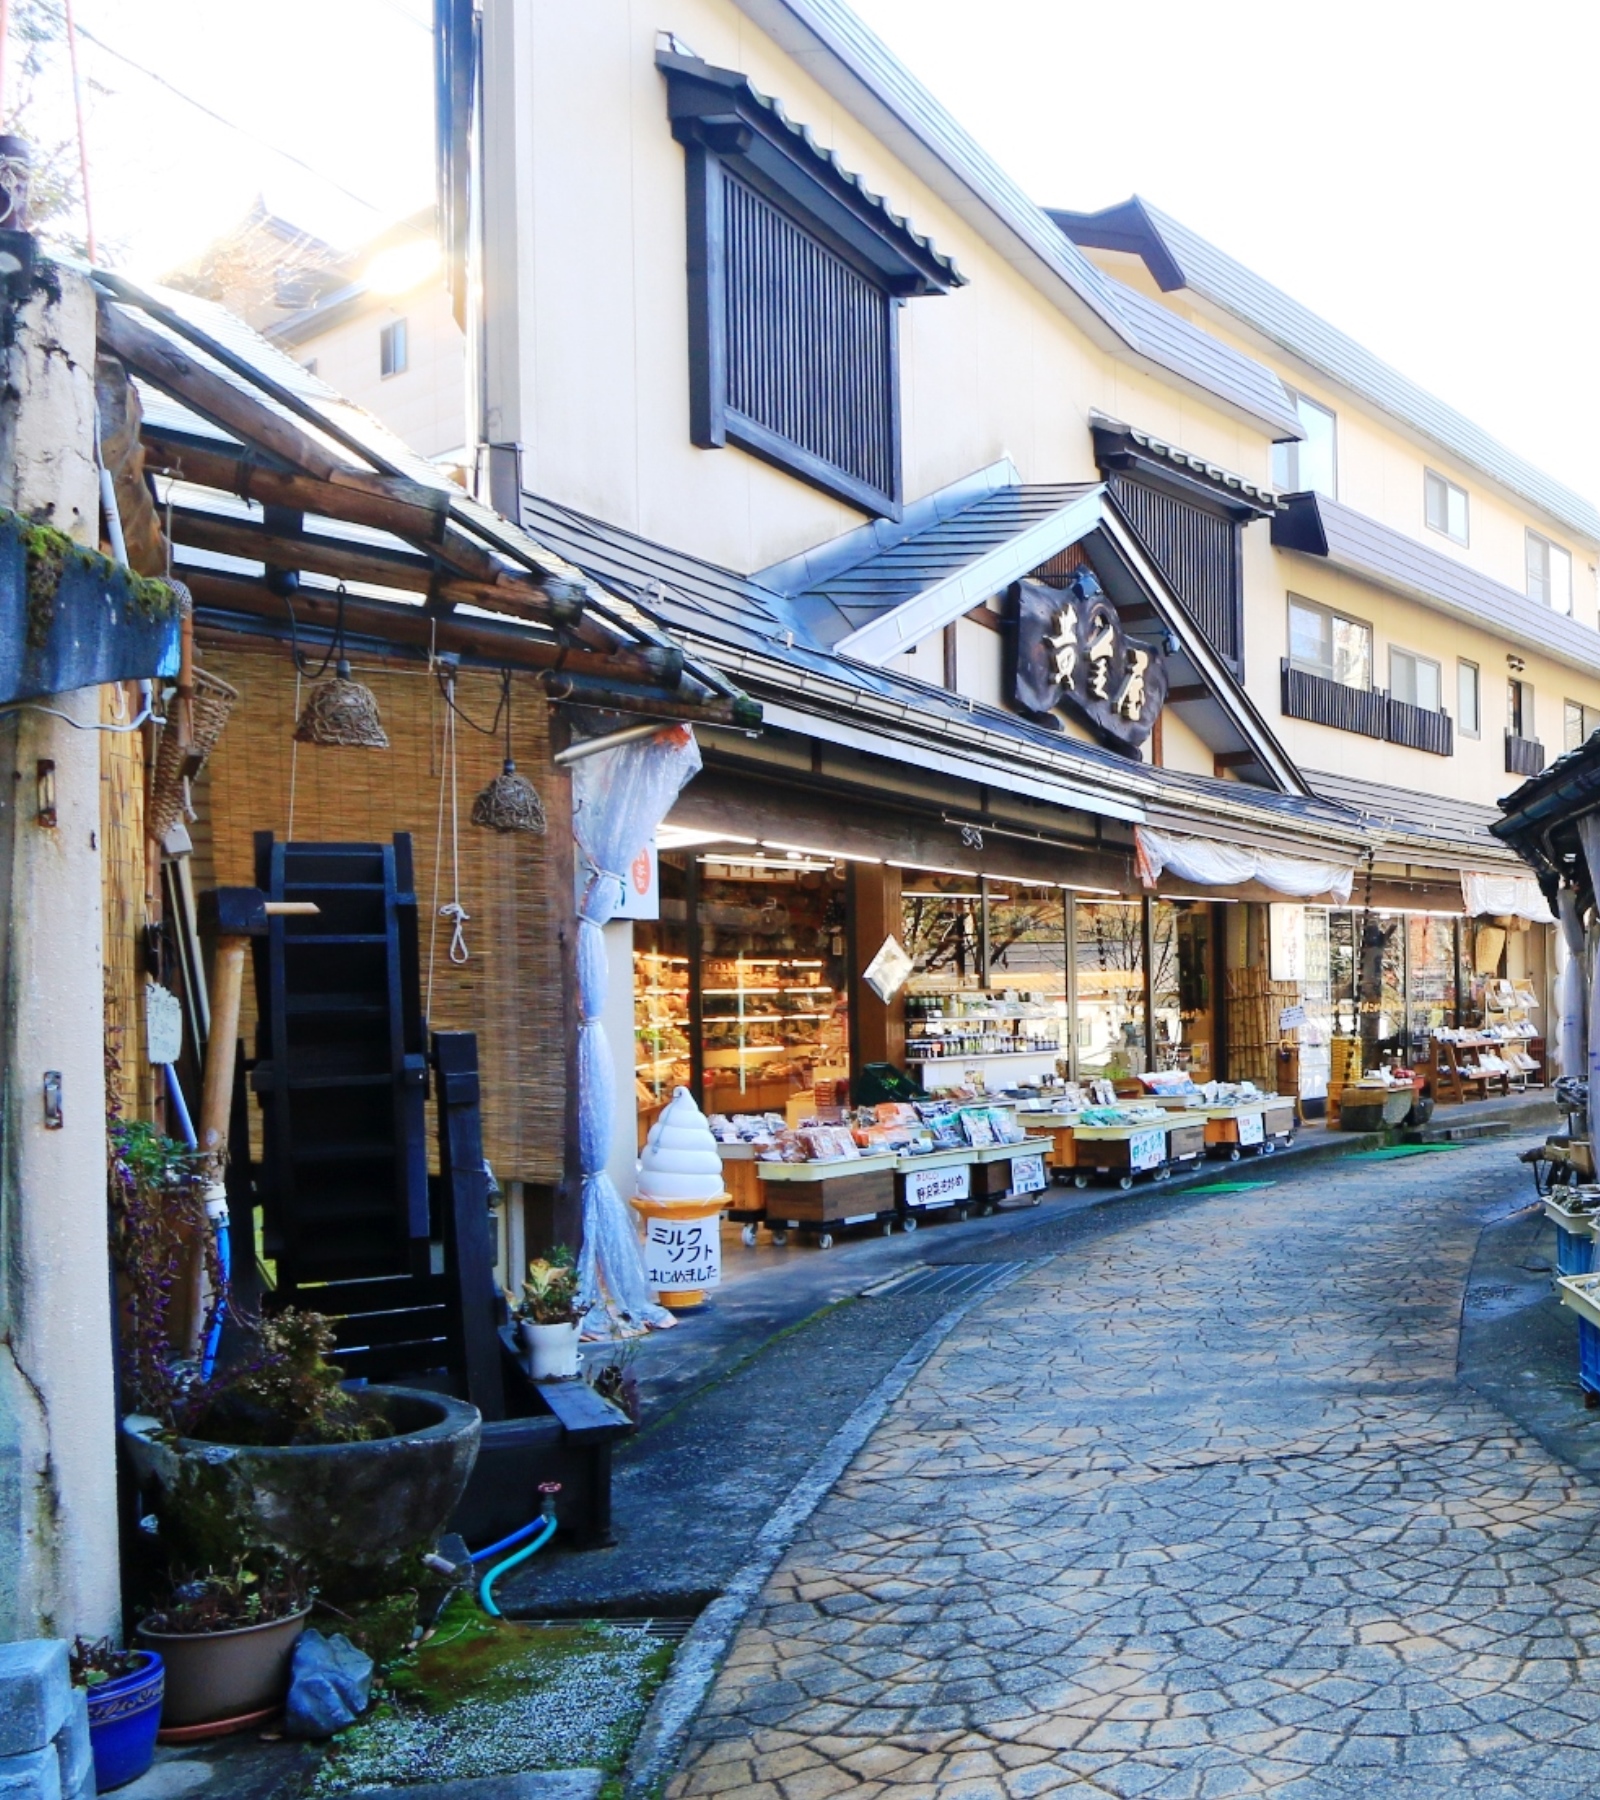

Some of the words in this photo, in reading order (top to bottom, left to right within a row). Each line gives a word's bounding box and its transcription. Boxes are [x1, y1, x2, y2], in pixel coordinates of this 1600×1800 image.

[652, 1227, 702, 1246] ミルク
[667, 1244, 713, 1263] ソフト
